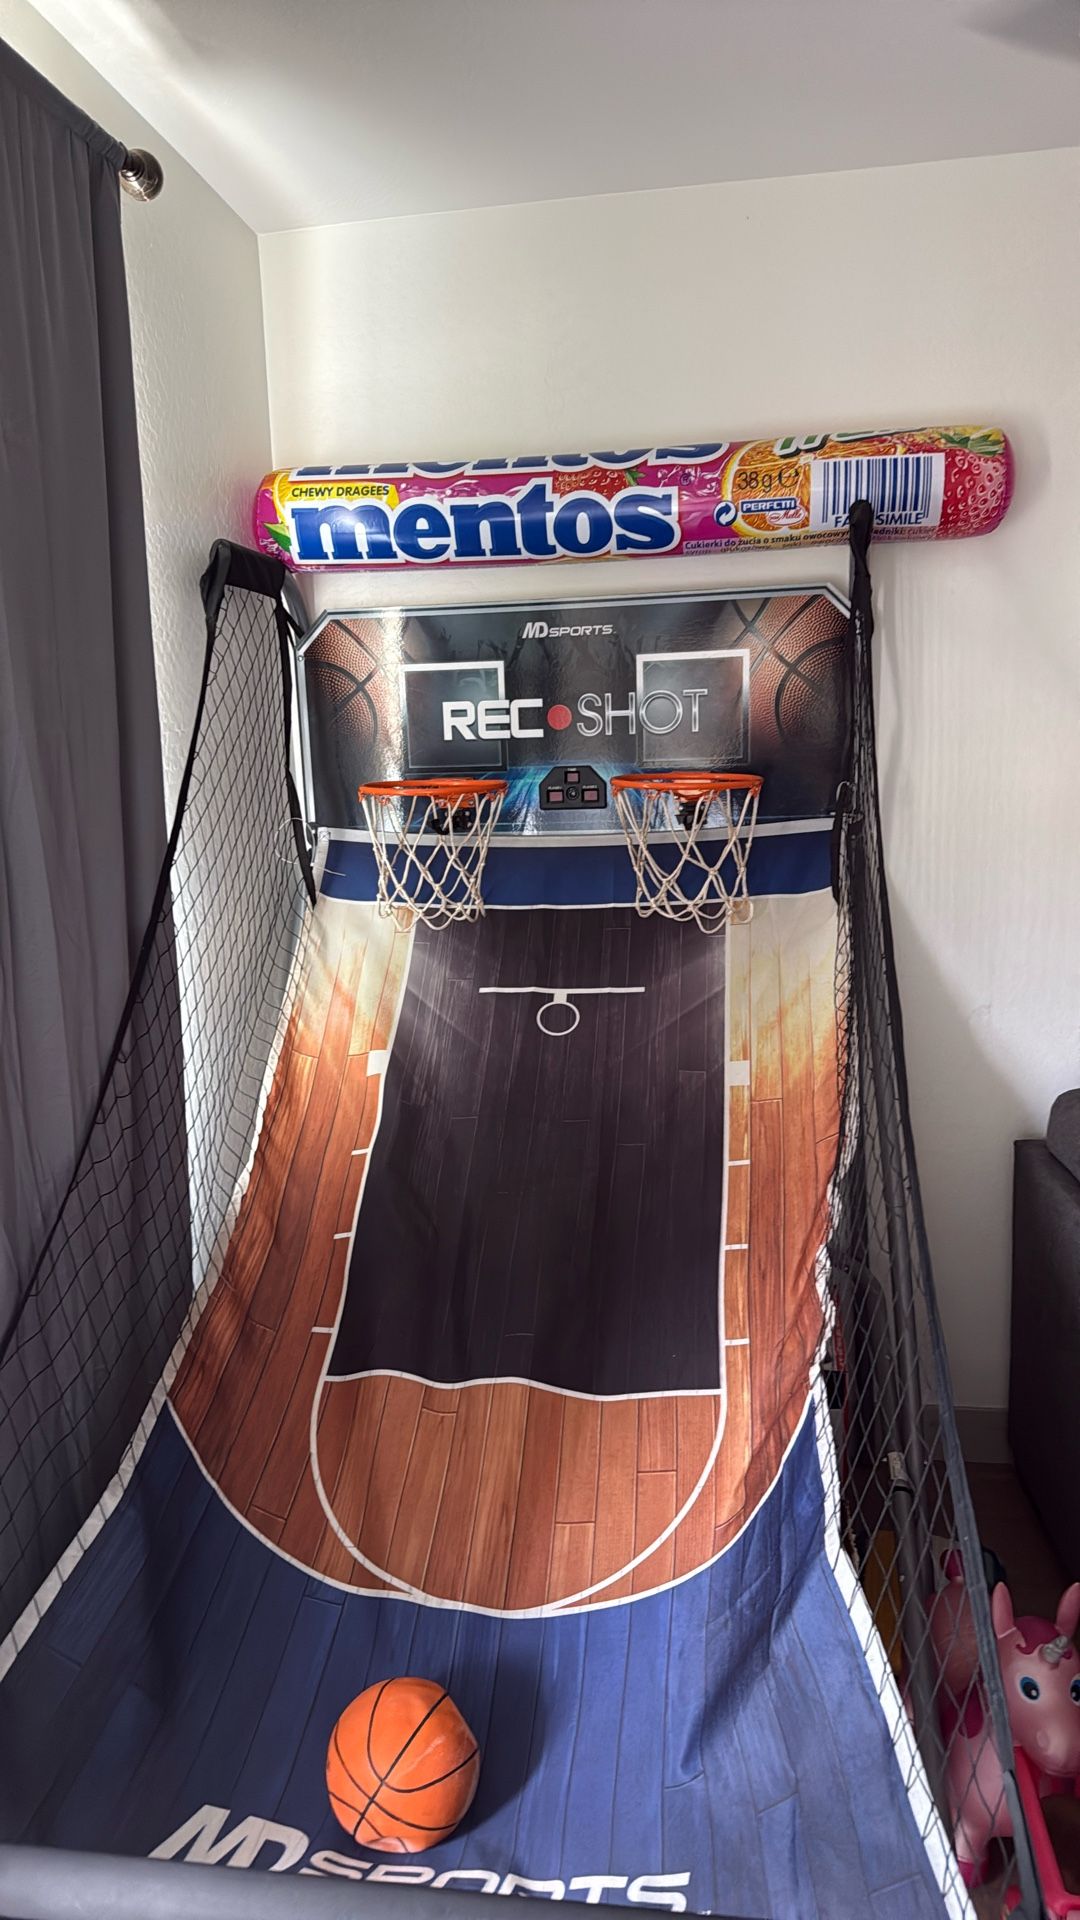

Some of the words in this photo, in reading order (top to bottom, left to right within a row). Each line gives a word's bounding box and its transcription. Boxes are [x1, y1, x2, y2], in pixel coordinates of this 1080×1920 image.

[291, 486, 333, 498] CHEWY
[336, 485, 390, 497] DRAGEES
[291, 483, 675, 560] mentos
[834, 512, 924, 528] FASIMILE
[685, 539, 723, 550] Cukierki
[724, 538, 736, 548] do
[771, 533, 801, 543] smaku
[522, 621, 549, 639] MD
[549, 625, 613, 638] SPORTS
[442, 698, 544, 741] REC
[576, 689, 708, 737] SHOT
